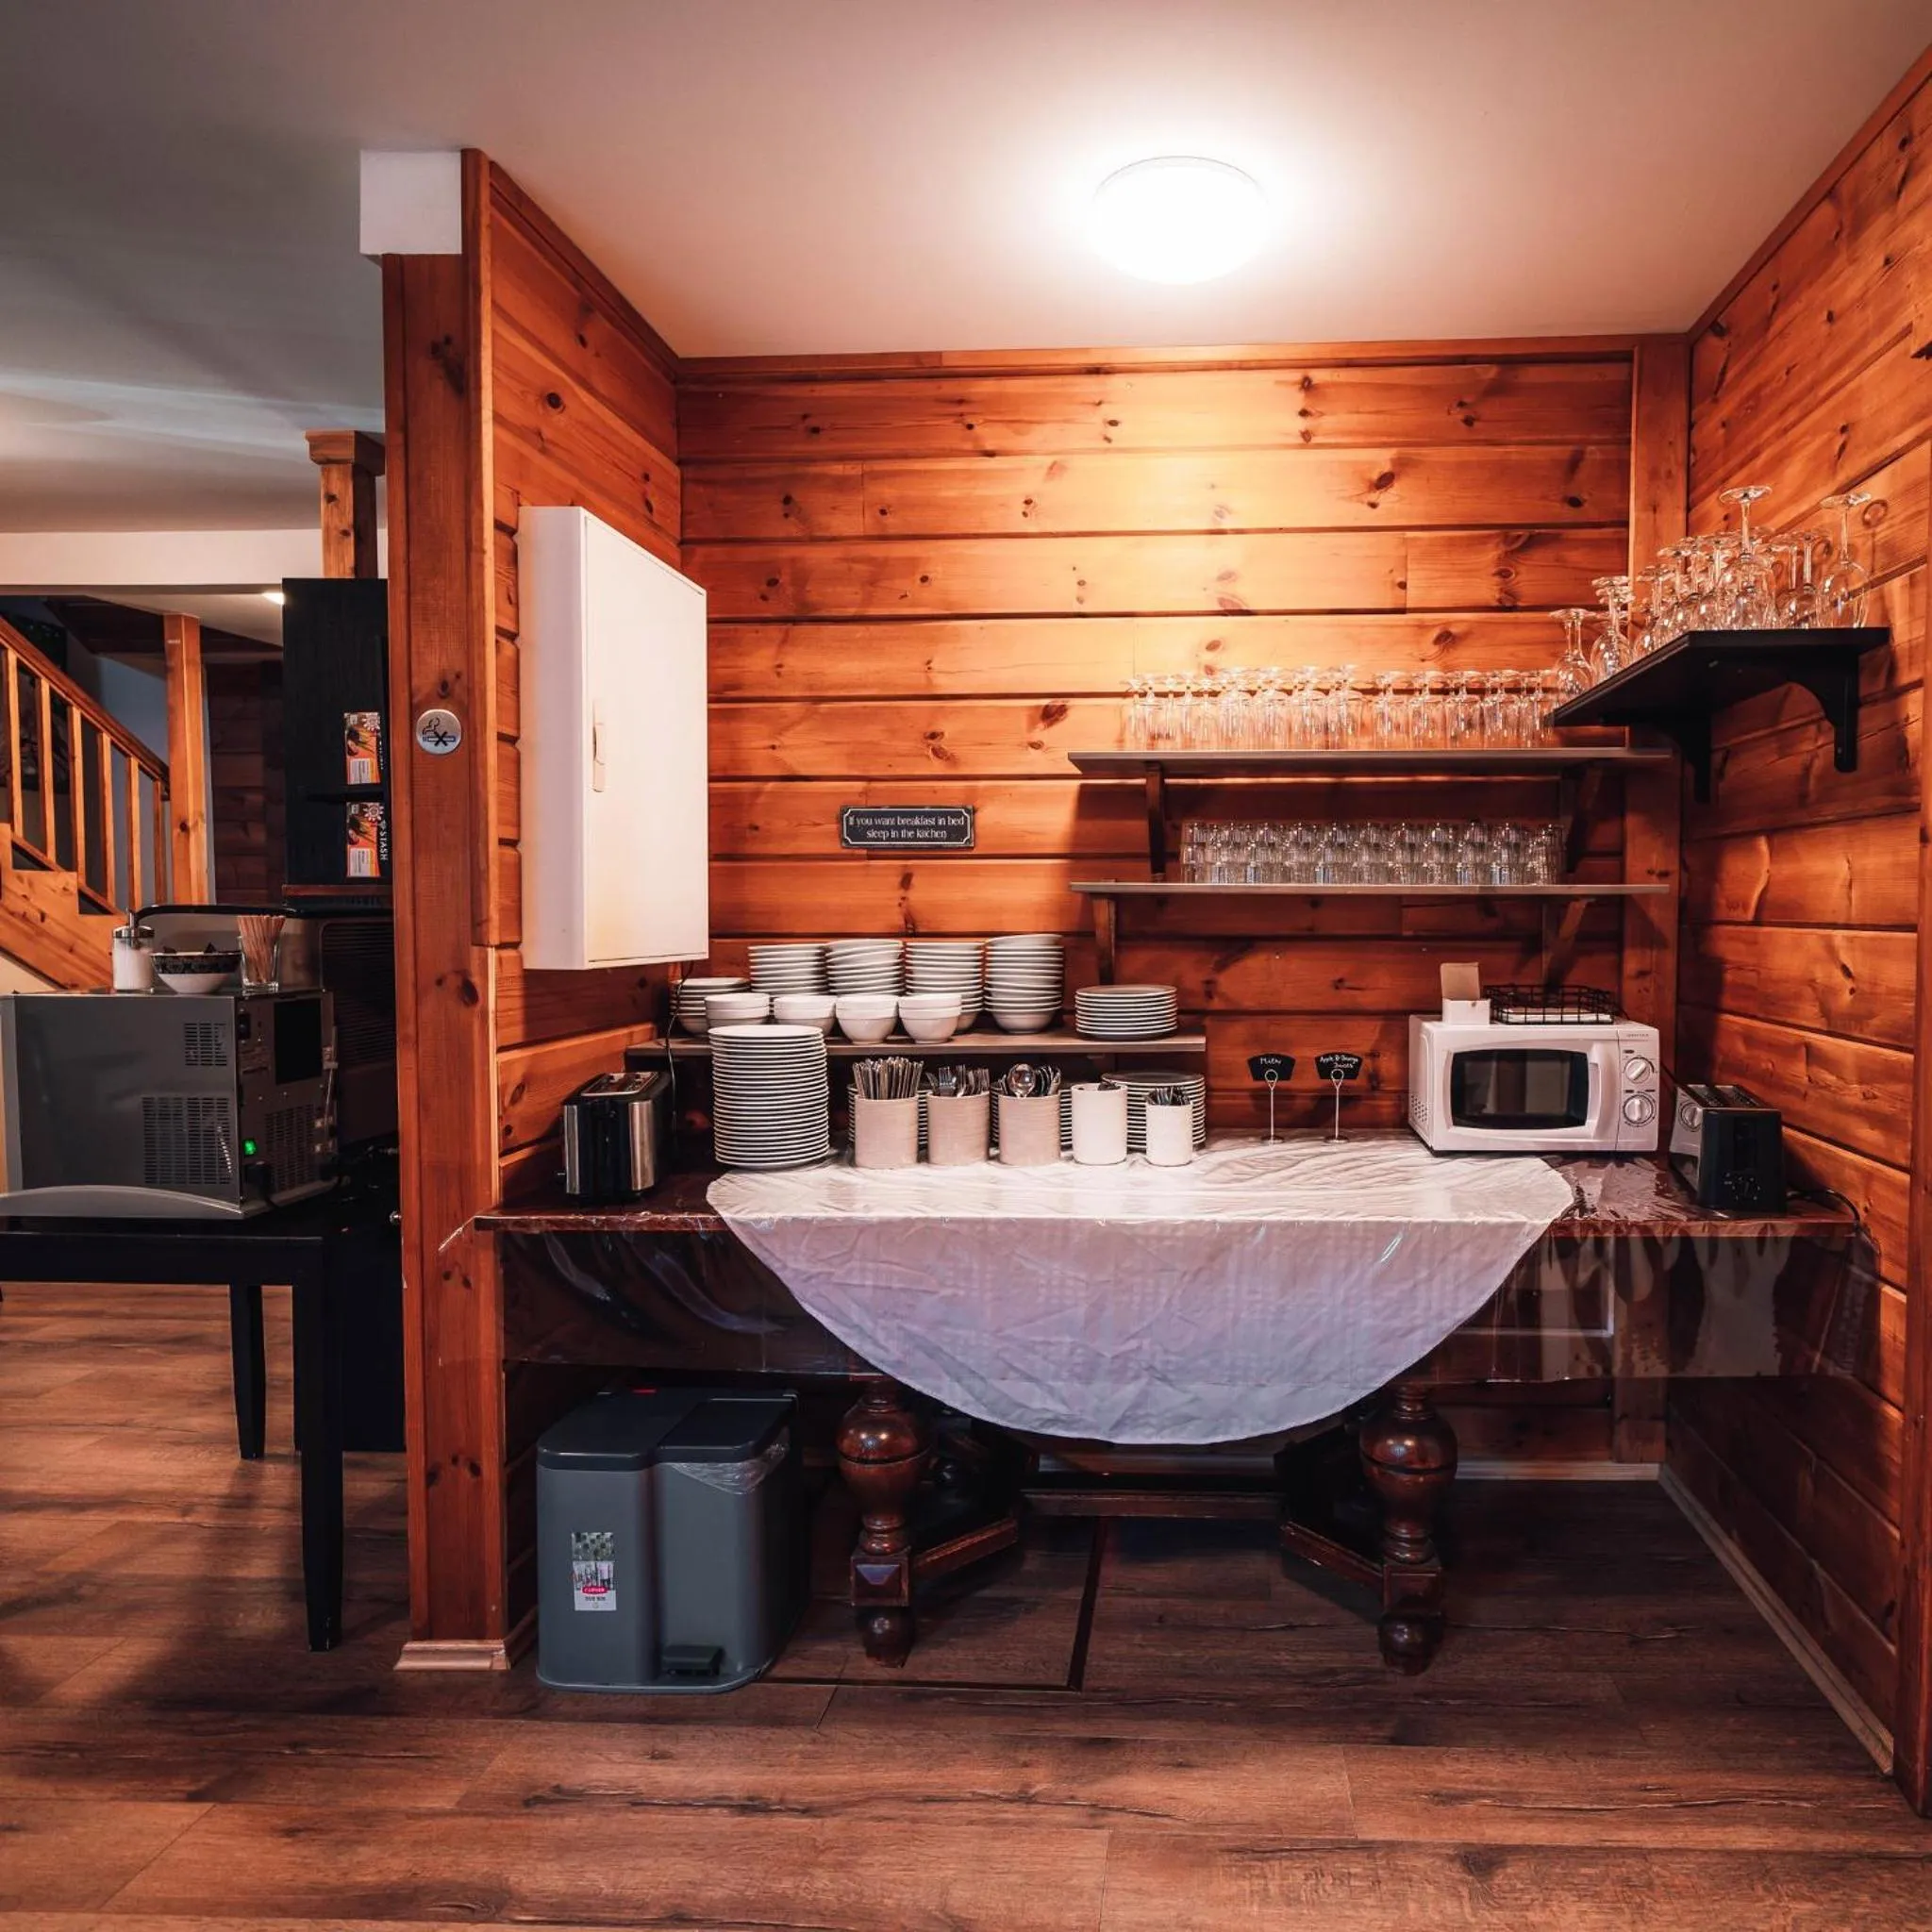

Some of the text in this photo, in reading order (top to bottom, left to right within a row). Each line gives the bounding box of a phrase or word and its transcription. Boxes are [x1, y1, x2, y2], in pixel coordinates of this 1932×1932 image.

[856, 817, 873, 827] you
[874, 816, 895, 825] want
[897, 815, 936, 825] breakfast
[938, 815, 946, 825] in
[947, 815, 965, 825] bed
[866, 828, 890, 841] sleep
[891, 828, 899, 838] in
[901, 828, 914, 839] the
[379, 830, 389, 862] STASH
